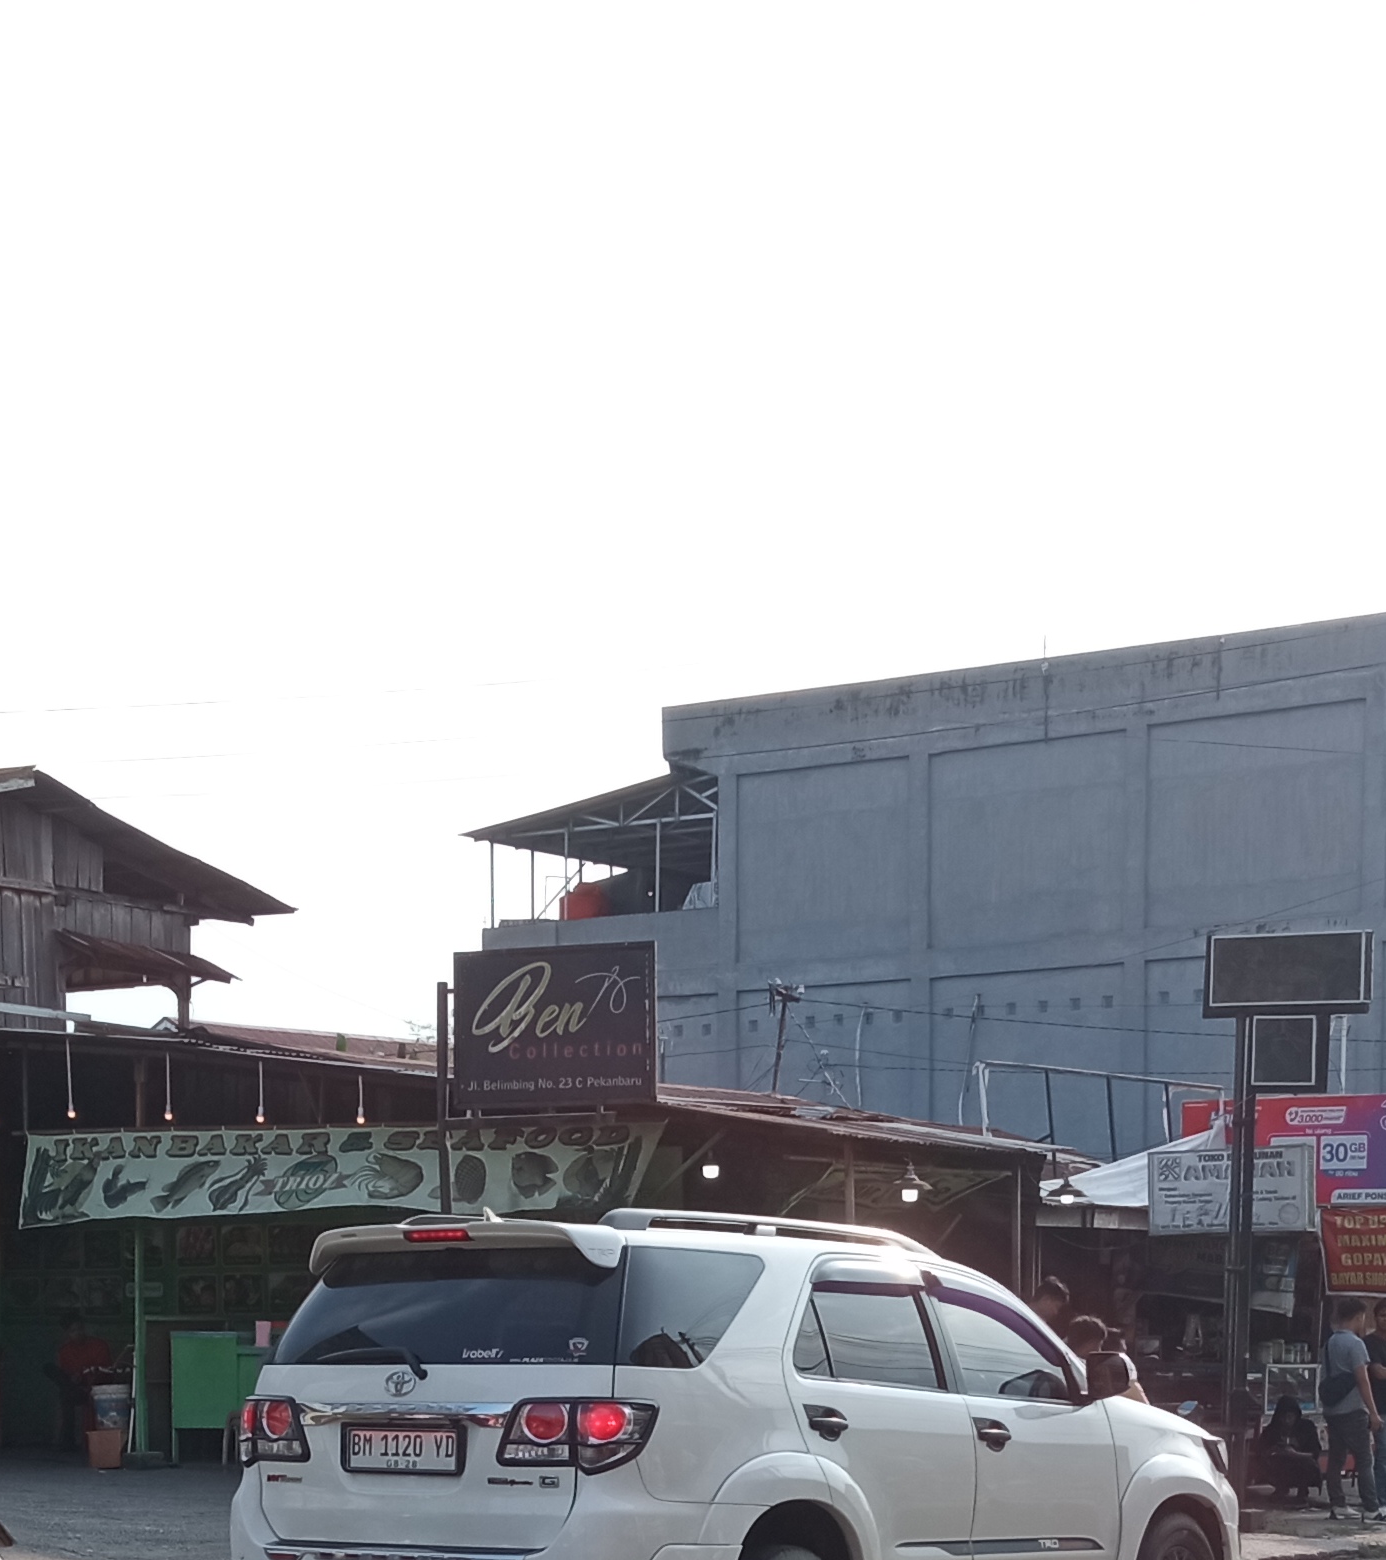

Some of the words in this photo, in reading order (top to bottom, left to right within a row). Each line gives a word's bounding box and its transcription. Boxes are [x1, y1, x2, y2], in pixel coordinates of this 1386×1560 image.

[472, 961, 587, 1054] Ben
[509, 1042, 643, 1060] Collection
[467, 1080, 481, 1092] Jl.
[483, 1079, 535, 1093] Belimbing
[538, 1077, 556, 1089] No.
[558, 1078, 572, 1089] 23
[576, 1077, 584, 1088] C
[587, 1075, 642, 1088] Pekanbaru
[51, 1135, 163, 1163] IKAN
[164, 1132, 331, 1160] BAKAR
[1321, 1142, 1349, 1163] 30
[1349, 1142, 1367, 1153] GB
[1198, 1153, 1225, 1163] TOKO
[1336, 1191, 1363, 1201] ARIEF
[1334, 1215, 1362, 1229] TOP
[351, 1433, 374, 1457] BM
[379, 1432, 424, 1457] 1120
[433, 1433, 456, 1458] YD
[542, 1477, 556, 1486] G
